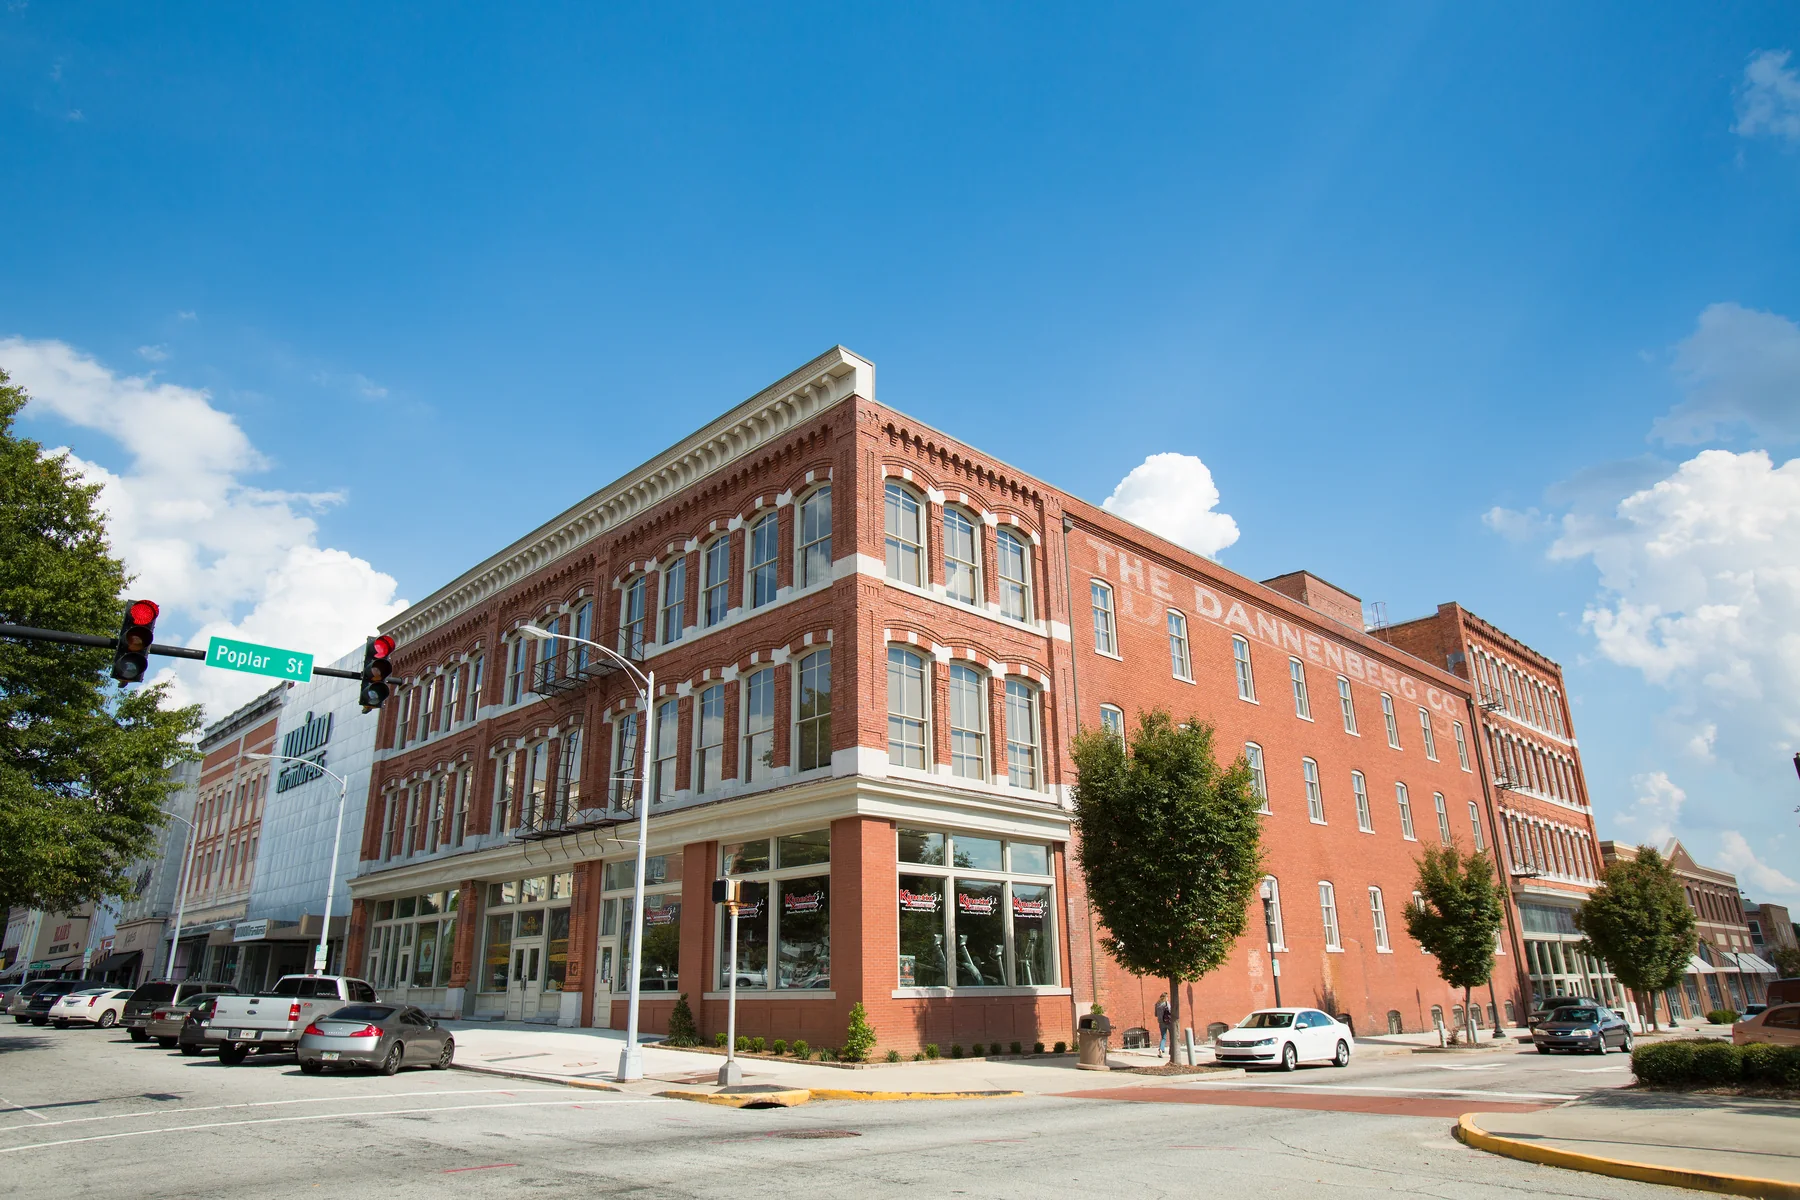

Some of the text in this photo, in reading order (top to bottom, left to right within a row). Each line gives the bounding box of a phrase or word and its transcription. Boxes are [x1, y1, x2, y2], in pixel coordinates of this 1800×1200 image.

[1086, 538, 1173, 602] THE
[1194, 585, 1417, 700] DANNENBERG
[216, 645, 304, 675] Poplar St
[281, 711, 332, 763] union
[900, 889, 934, 906] Kinetix
[959, 893, 989, 910] Kinetix
